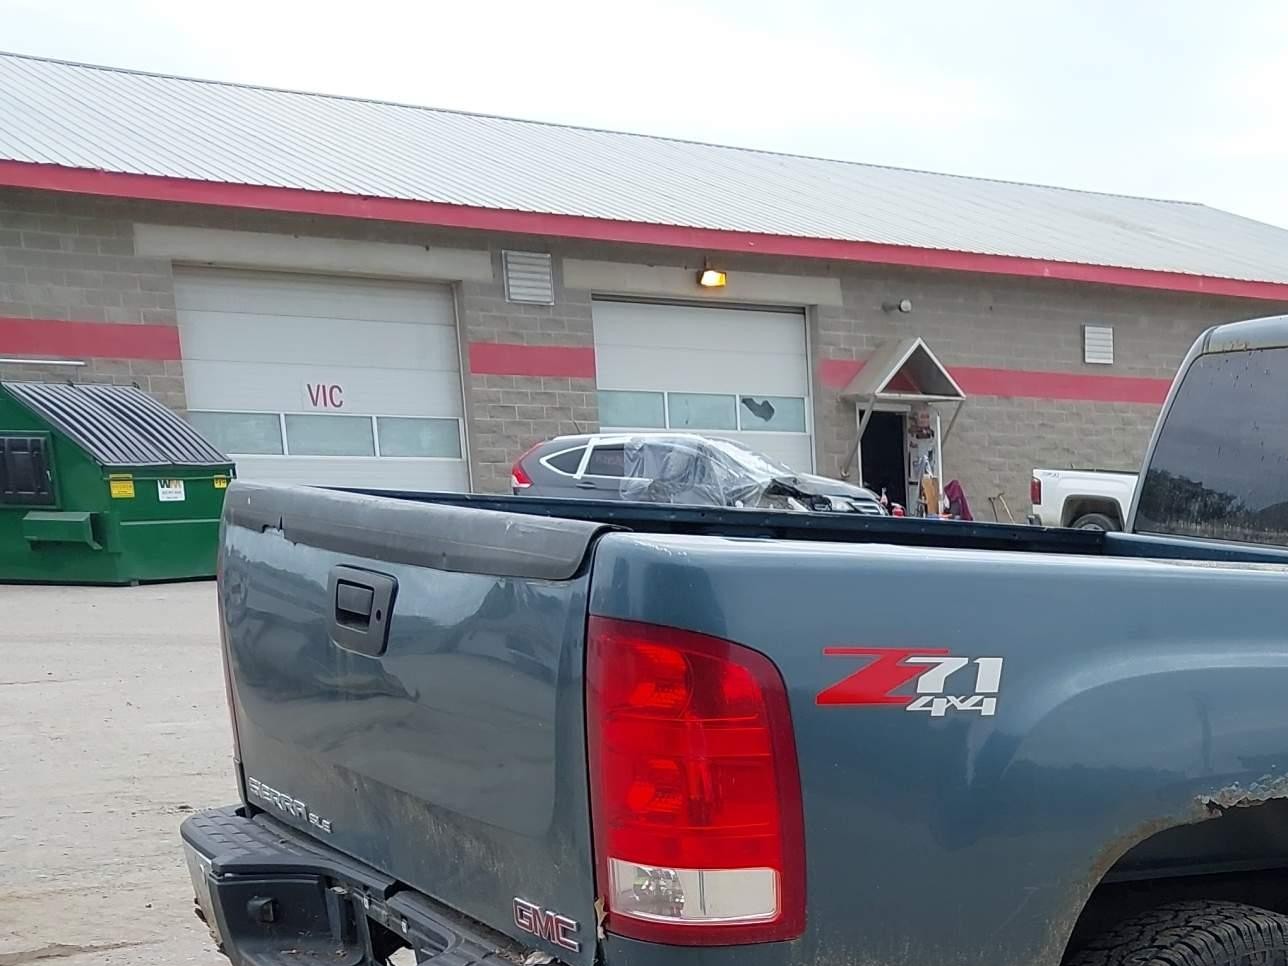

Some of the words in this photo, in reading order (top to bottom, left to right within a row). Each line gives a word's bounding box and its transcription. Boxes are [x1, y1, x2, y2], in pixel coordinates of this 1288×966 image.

[307, 383, 343, 408] VIC
[815, 647, 1004, 706] Z71
[247, 776, 308, 823] SIERRA
[308, 811, 333, 834] SLE
[513, 897, 580, 953] GMC
